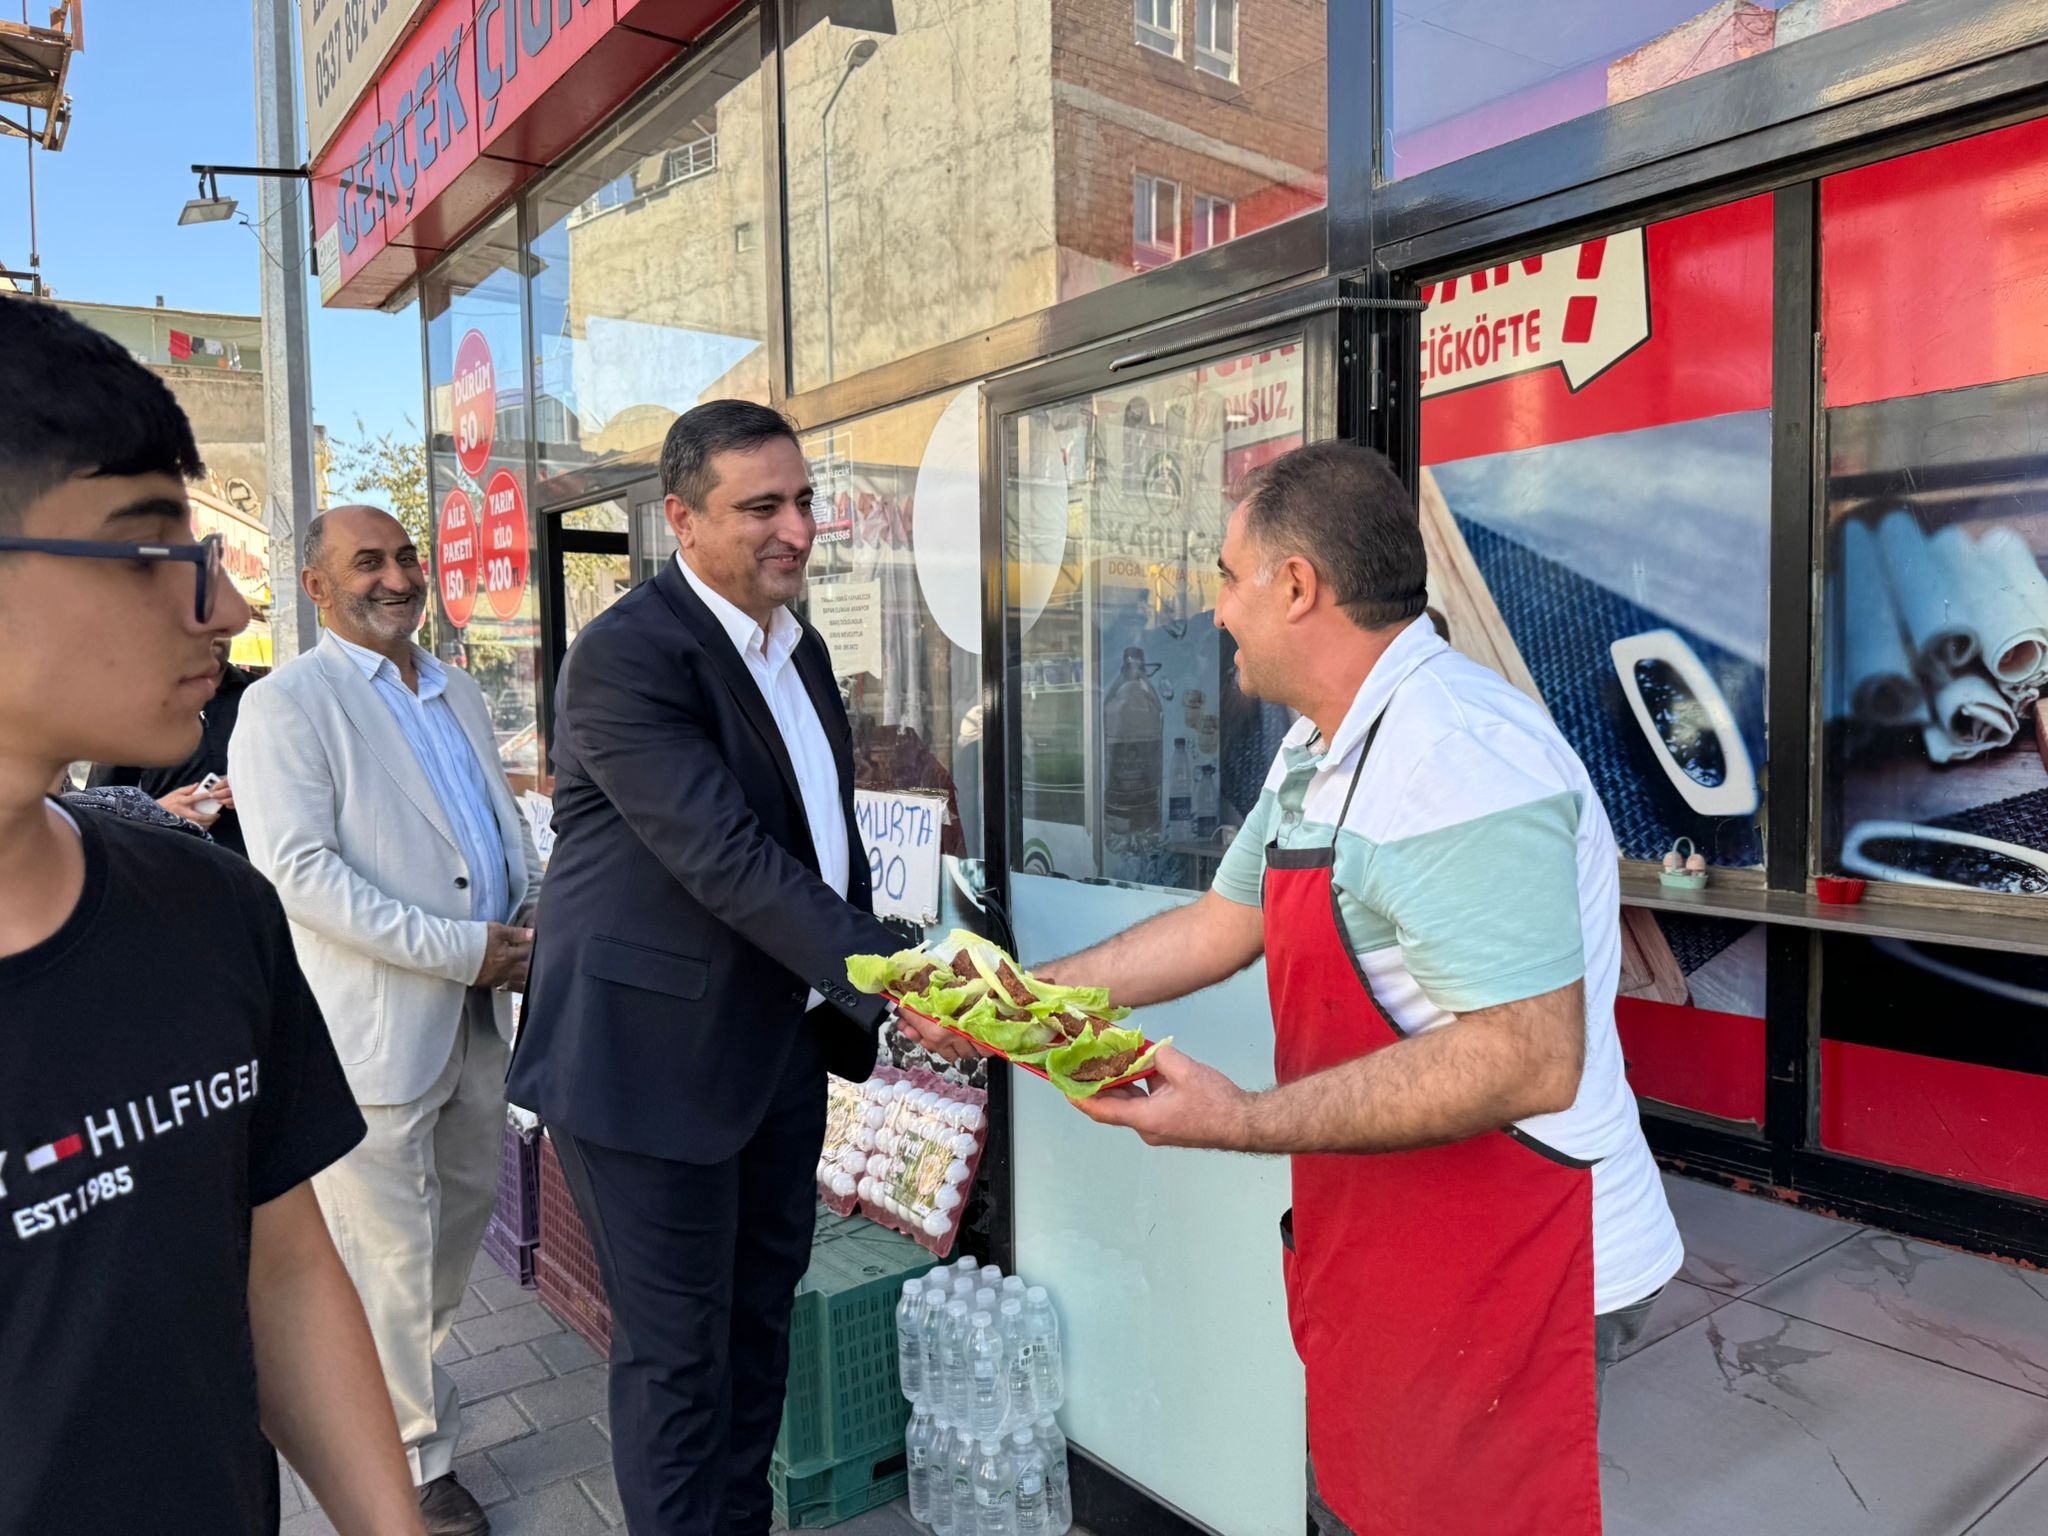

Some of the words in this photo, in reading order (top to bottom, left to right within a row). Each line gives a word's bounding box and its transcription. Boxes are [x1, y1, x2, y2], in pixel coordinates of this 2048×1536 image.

[315, 17, 341, 108] 0537
[345, 0, 368, 63] 892
[337, 23, 468, 256] GERÇEK
[477, 0, 590, 131] ÇI
[454, 360, 491, 407] DÜRÜM
[460, 410, 478, 454] 50
[447, 502, 466, 530] AİLE
[489, 488, 515, 516] YARIM
[443, 532, 473, 564] PAKETİ
[493, 521, 513, 550] KİLO
[445, 568, 464, 601] 150
[488, 556, 512, 592] 200
[869, 846, 906, 900] 90
